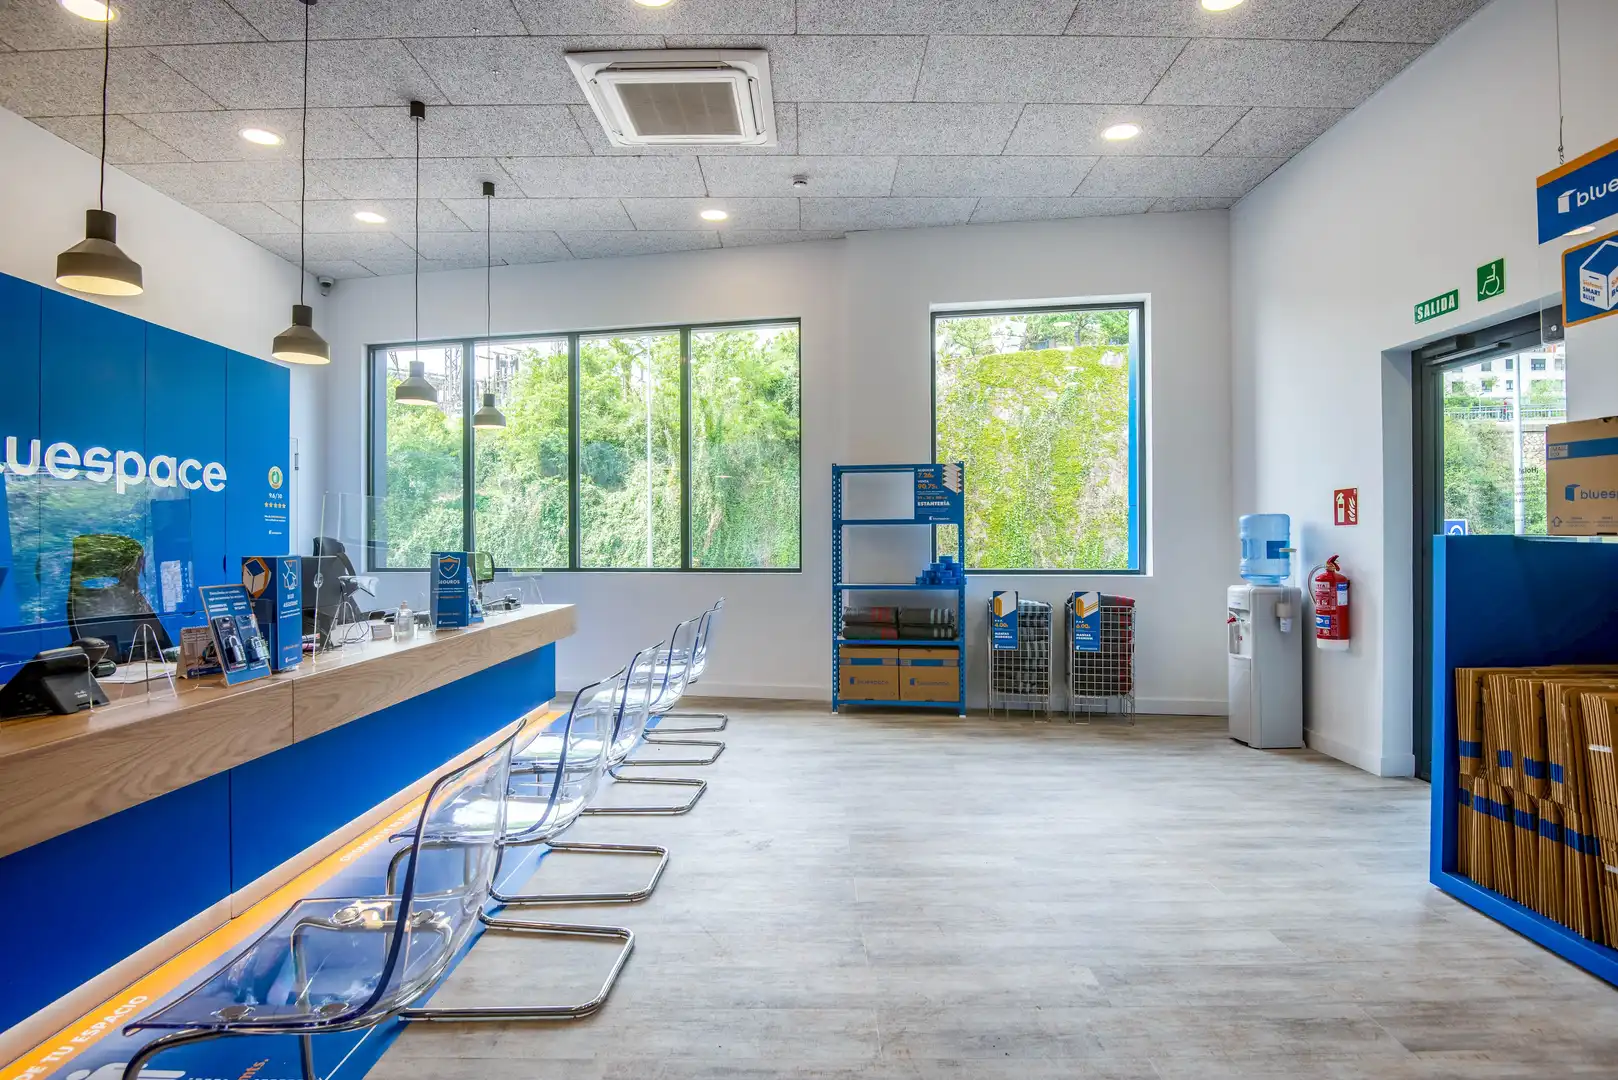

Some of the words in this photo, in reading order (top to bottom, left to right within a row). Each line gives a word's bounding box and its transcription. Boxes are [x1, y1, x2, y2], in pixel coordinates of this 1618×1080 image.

[1582, 286, 1601, 296] SMART
[1582, 293, 1596, 302] BLUE
[1417, 294, 1456, 320] SALIDA
[0, 436, 227, 494] uespace
[44, 1045, 75, 1063] TU
[78, 995, 149, 1044] ESPACIO
